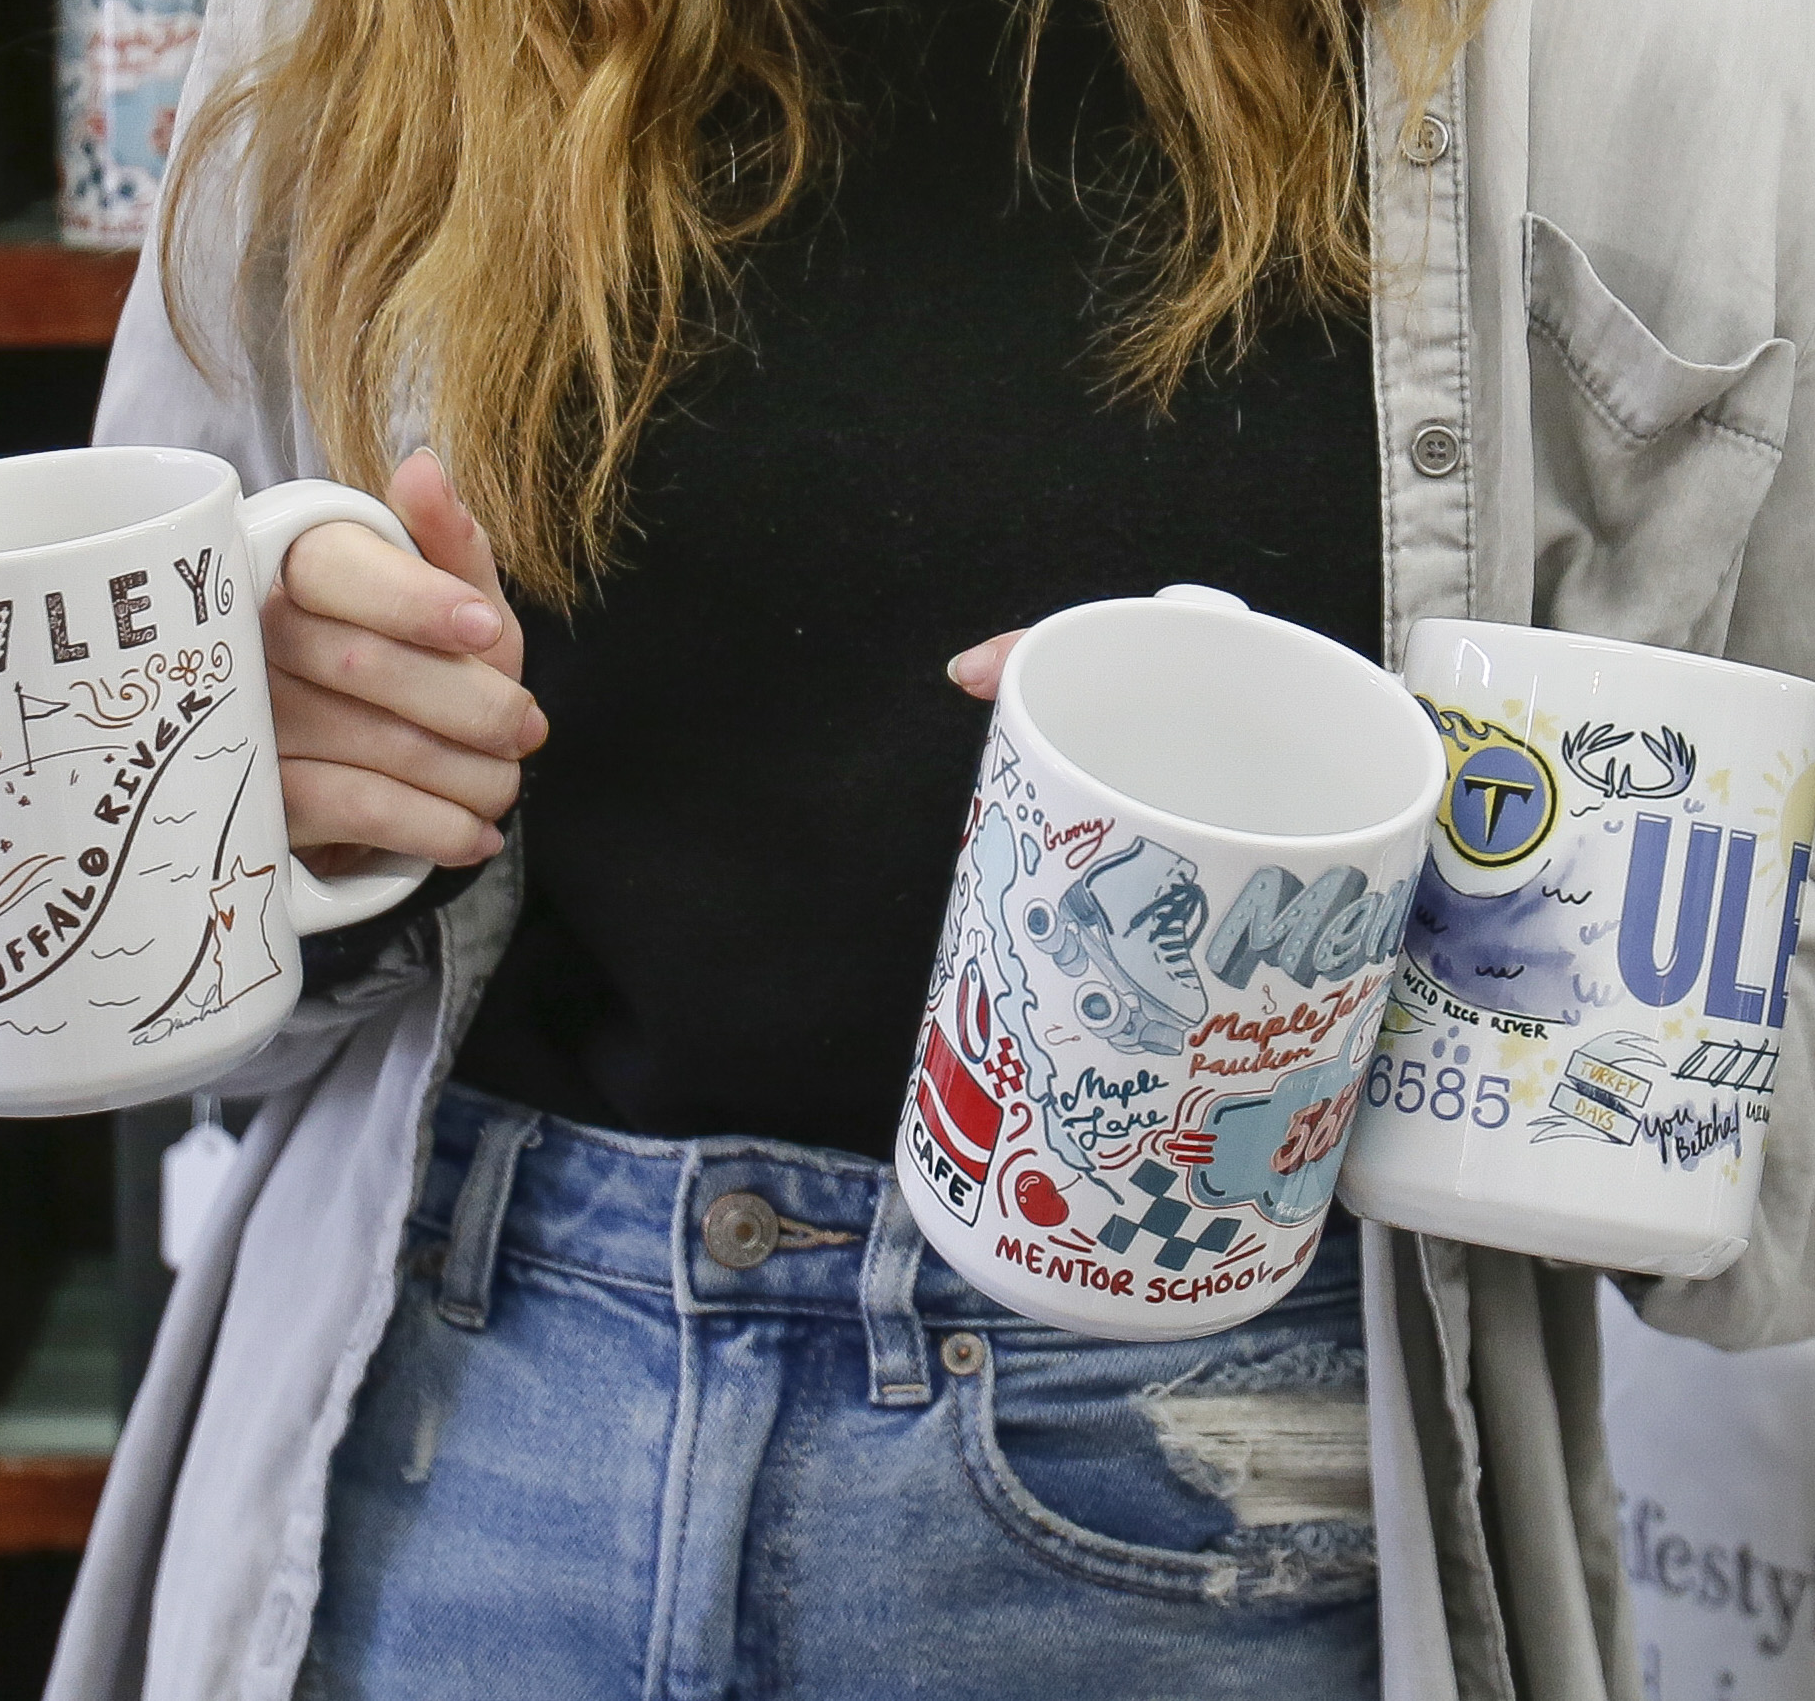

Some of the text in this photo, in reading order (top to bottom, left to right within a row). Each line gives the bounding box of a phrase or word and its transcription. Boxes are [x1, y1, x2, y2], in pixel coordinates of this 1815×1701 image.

[92, 688, 214, 827] RIVER
[1188, 1002, 1328, 1052] Maple
[1402, 966, 1549, 1041] WILD RICE RIVER
[1061, 1066, 1170, 1111] Maple
[1366, 1052, 1512, 1131] 6585
[1581, 1059, 1642, 1096] TURKEY
[1061, 1107, 1170, 1151] Lake
[1573, 1098, 1617, 1132] DAYS
[912, 1119, 974, 1208] CAFE
[994, 1234, 1274, 1304] MENTOR SCHOOL
